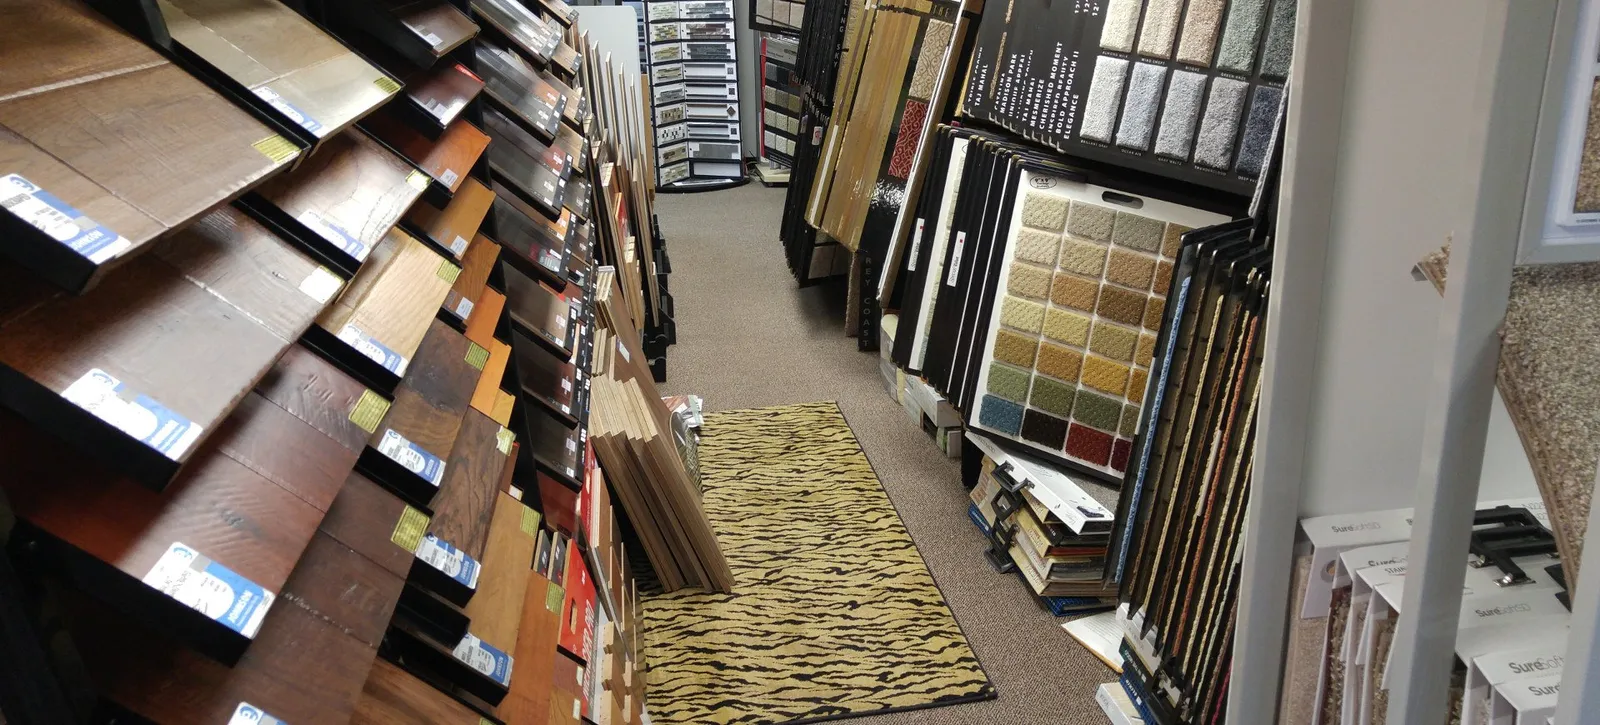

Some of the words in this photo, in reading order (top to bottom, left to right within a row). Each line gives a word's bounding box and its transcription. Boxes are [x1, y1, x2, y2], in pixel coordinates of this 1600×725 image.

[974, 93, 982, 106] TAJ
[978, 64, 988, 90] MAHAL
[1000, 76, 1012, 113] MADISON
[1008, 54, 1017, 74] PARK
[1030, 79, 1045, 127] MESMERIZE
[1039, 82, 1054, 130] CHERISHED
[1050, 42, 1062, 79] MOMENT
[1056, 110, 1065, 134] BOLD
[1062, 61, 1077, 108] APPROACH
[1064, 94, 1079, 139] ELEGANCE
[863, 298, 871, 346] COAST
[1475, 603, 1531, 617] SureSoftSD
